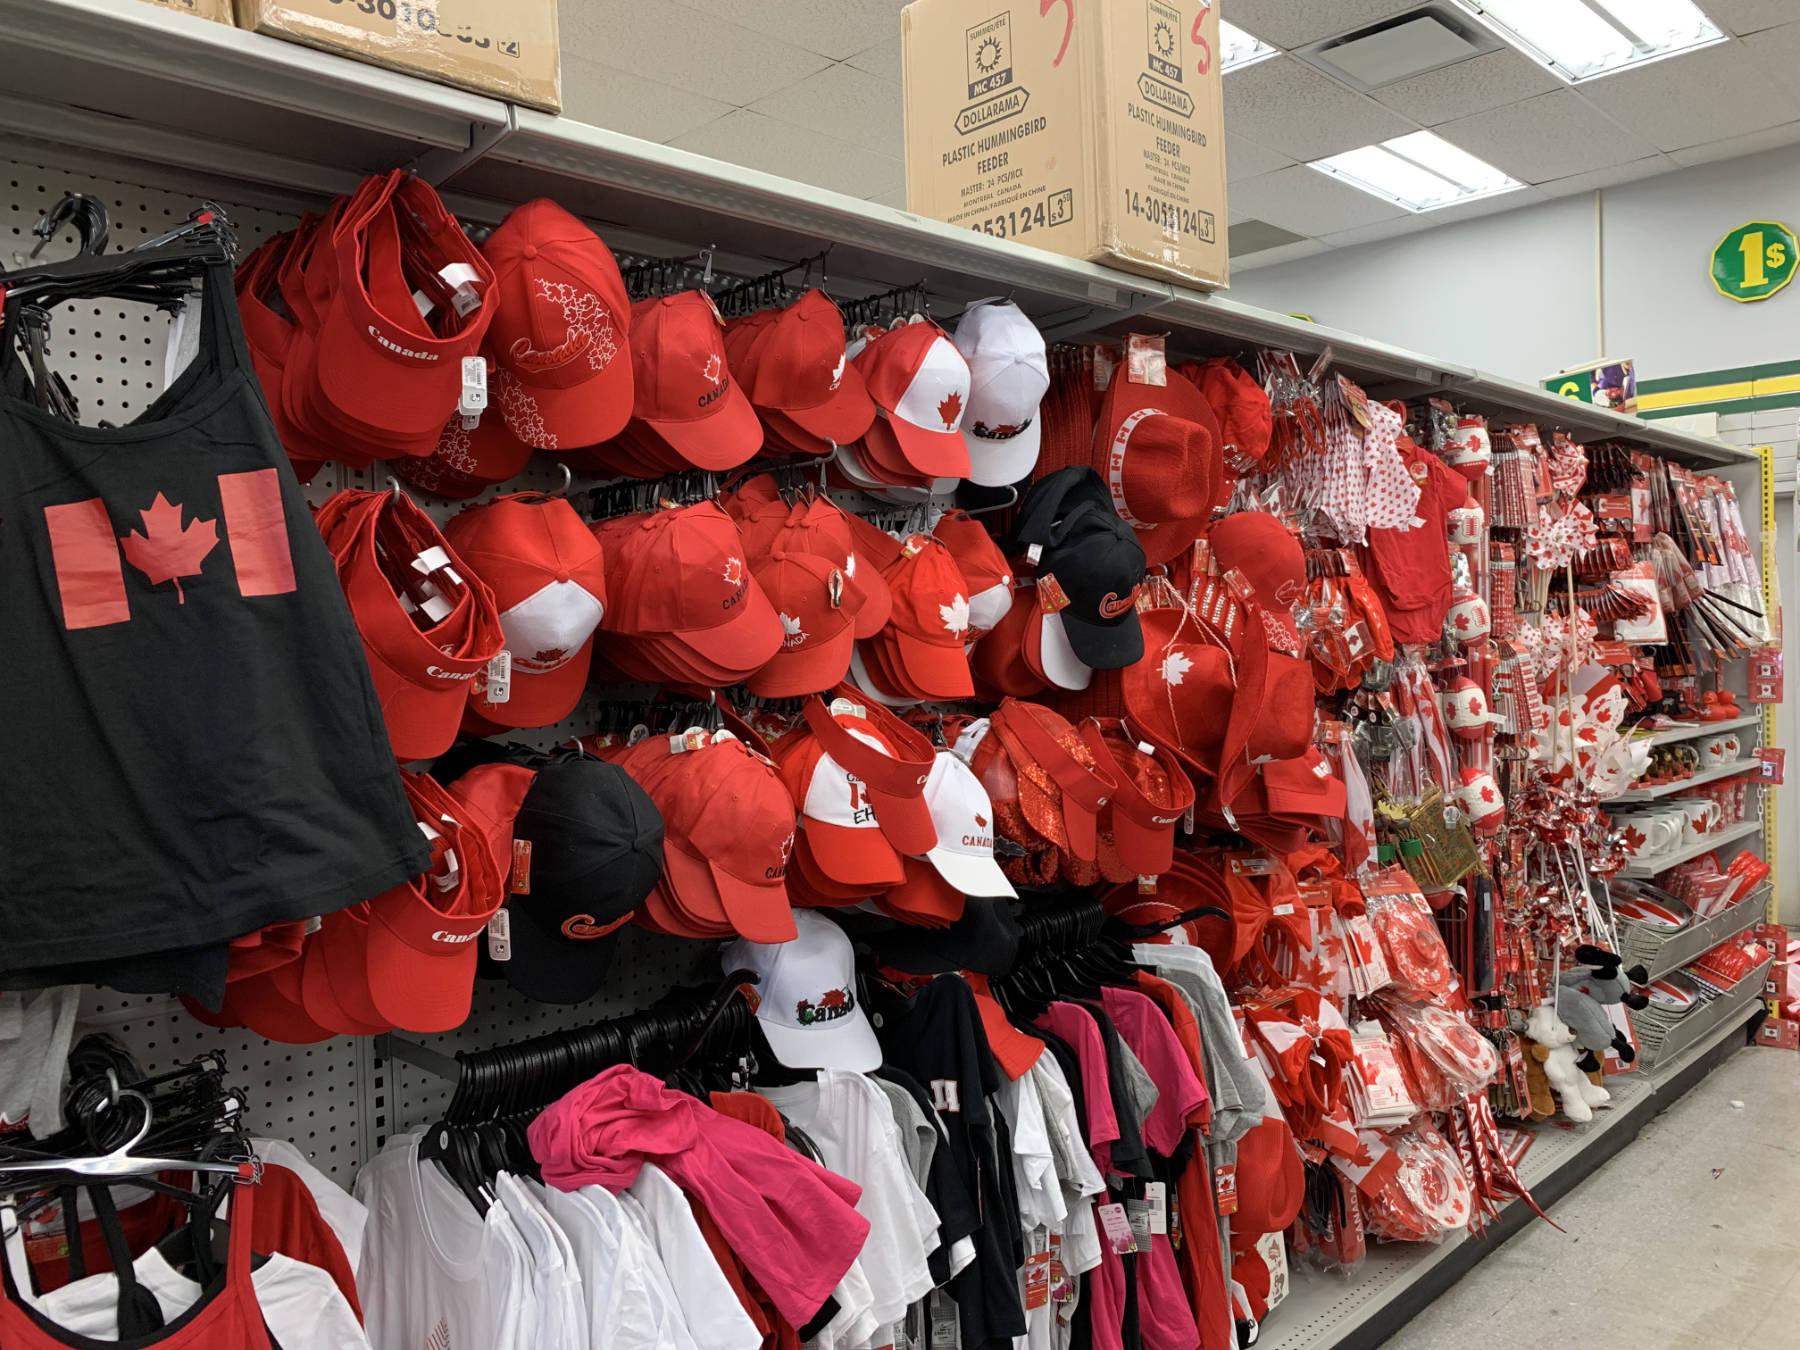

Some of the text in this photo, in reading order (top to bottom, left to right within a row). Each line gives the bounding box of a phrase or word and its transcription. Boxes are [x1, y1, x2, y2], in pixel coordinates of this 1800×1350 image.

[1152, 58, 1179, 79] MC 457
[973, 72, 1007, 97] MC 457
[1144, 80, 1188, 111] DOLLARAMA
[963, 94, 1020, 128] DOLLARAMA
[1127, 103, 1207, 147] PLASTIC HUMMINGBIRD
[942, 116, 1047, 167] PLASTIC HUMMINGBIRD
[1156, 136, 1180, 157] FEEDER
[977, 152, 1009, 175] FEEDER
[996, 183, 1022, 196] CANADA
[368, 325, 439, 360] Canada
[1349, 1184, 1365, 1242] CANADA
